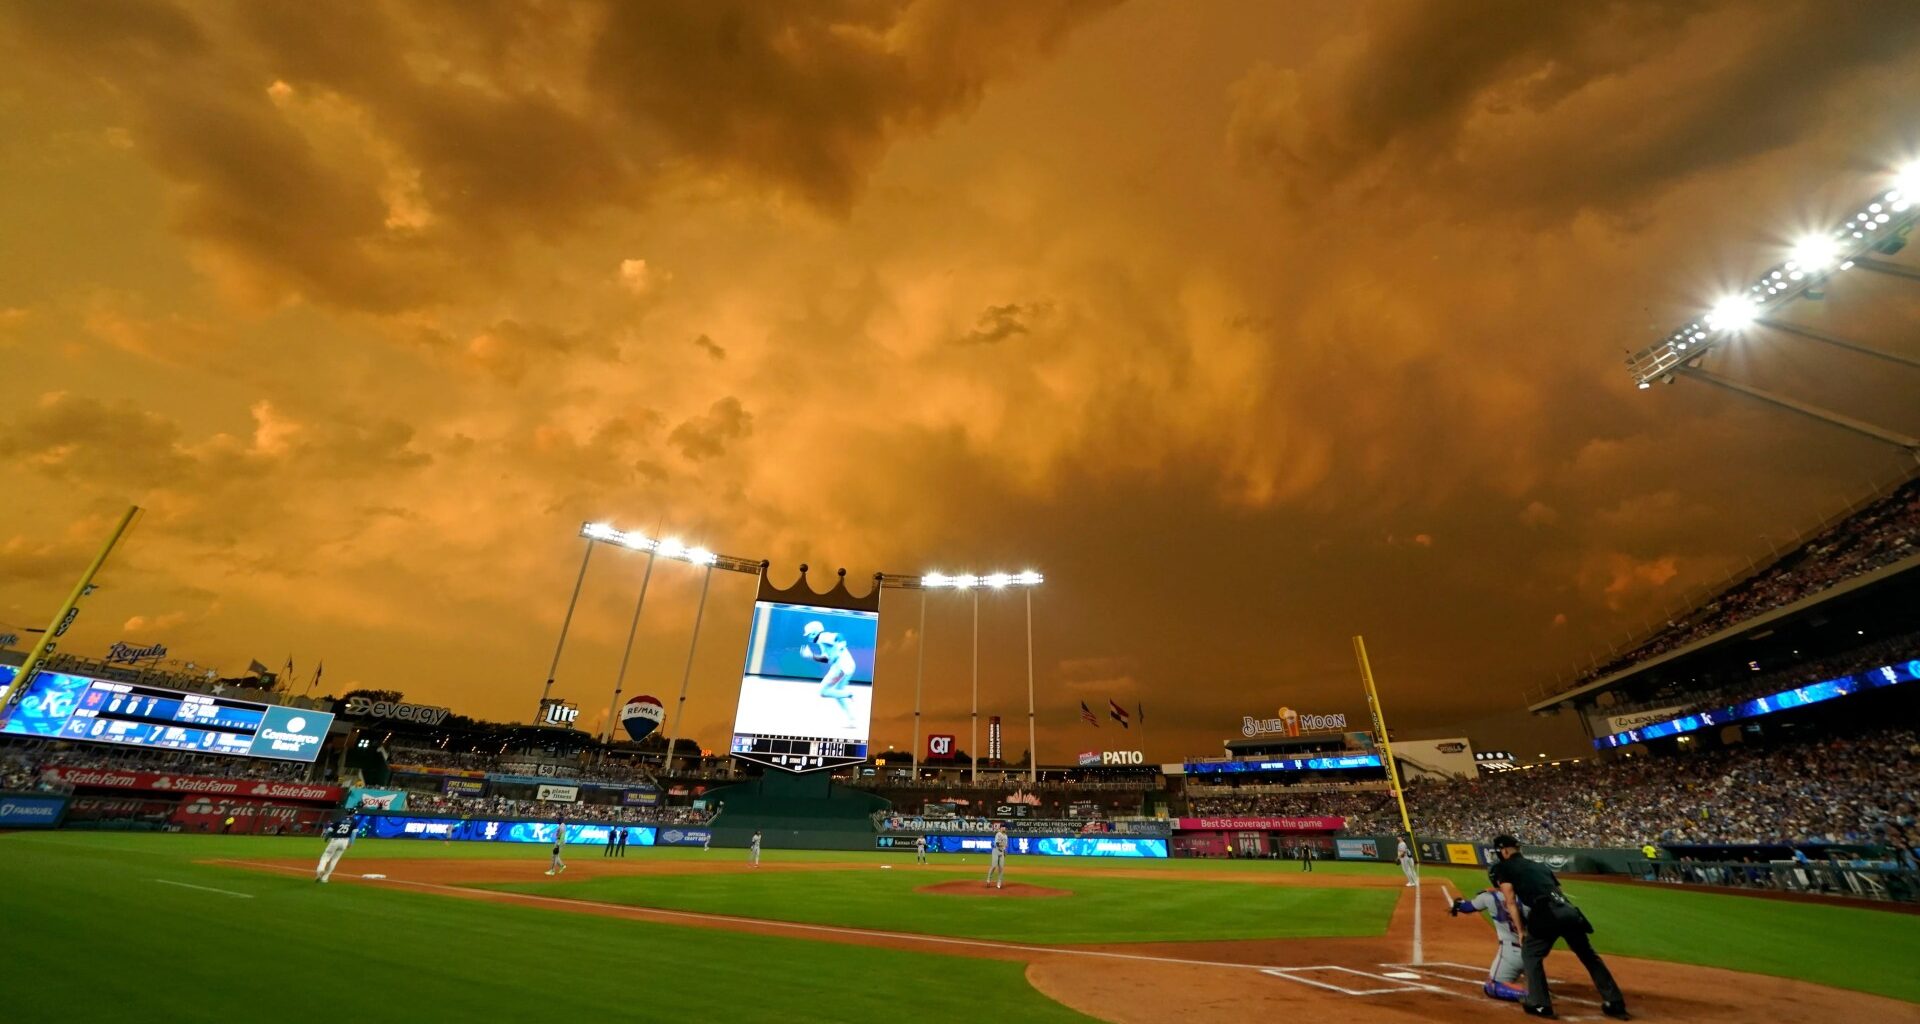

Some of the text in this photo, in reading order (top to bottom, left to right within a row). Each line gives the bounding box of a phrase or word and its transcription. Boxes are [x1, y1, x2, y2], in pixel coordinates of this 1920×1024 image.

[106, 641, 167, 664] Royals
[373, 702, 449, 725] evergy
[545, 704, 579, 724] Lite
[627, 707, 660, 717] RE/MAX
[1242, 716, 1282, 737] BLUE
[1300, 713, 1347, 731] MOON
[930, 737, 950, 754] QT
[1103, 751, 1143, 765] PATIO
[363, 798, 390, 807] SONIC
[337, 824, 350, 834] 25
[405, 823, 426, 833] NEW
[426, 823, 448, 834] YORK
[903, 820, 991, 831] FOUNTAIN DECK
[1201, 819, 1323, 829] Best 5G coverage in the game
